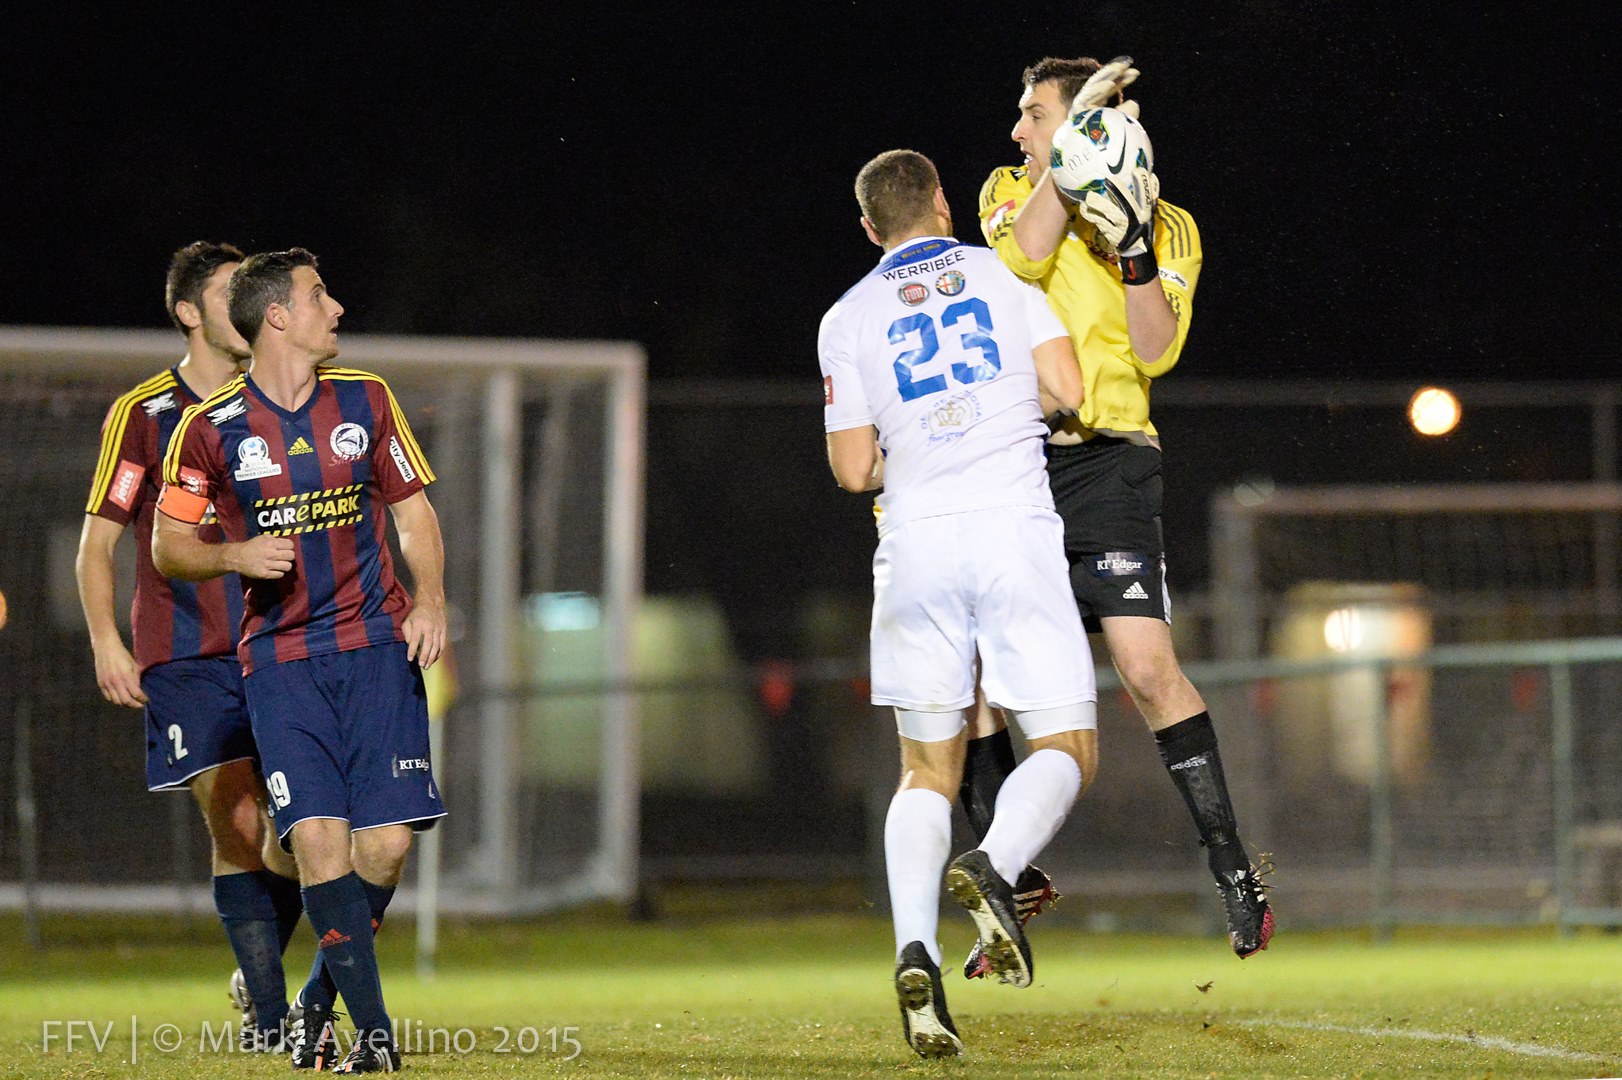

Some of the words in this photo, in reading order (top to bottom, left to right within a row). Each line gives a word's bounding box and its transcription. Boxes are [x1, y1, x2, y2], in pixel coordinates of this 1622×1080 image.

[883, 250, 965, 281] WERRIBEE
[904, 287, 925, 302] FIAT
[887, 297, 1002, 403] 23
[389, 439, 400, 457] City
[398, 459, 412, 479] Jeep
[115, 470, 135, 504] jetts
[1096, 559, 1111, 571] RT
[1112, 559, 1143, 571] Edgar
[168, 723, 188, 760] 2
[398, 759, 414, 770] RT
[1170, 758, 1207, 770] adidas
[266, 771, 291, 811] 19
